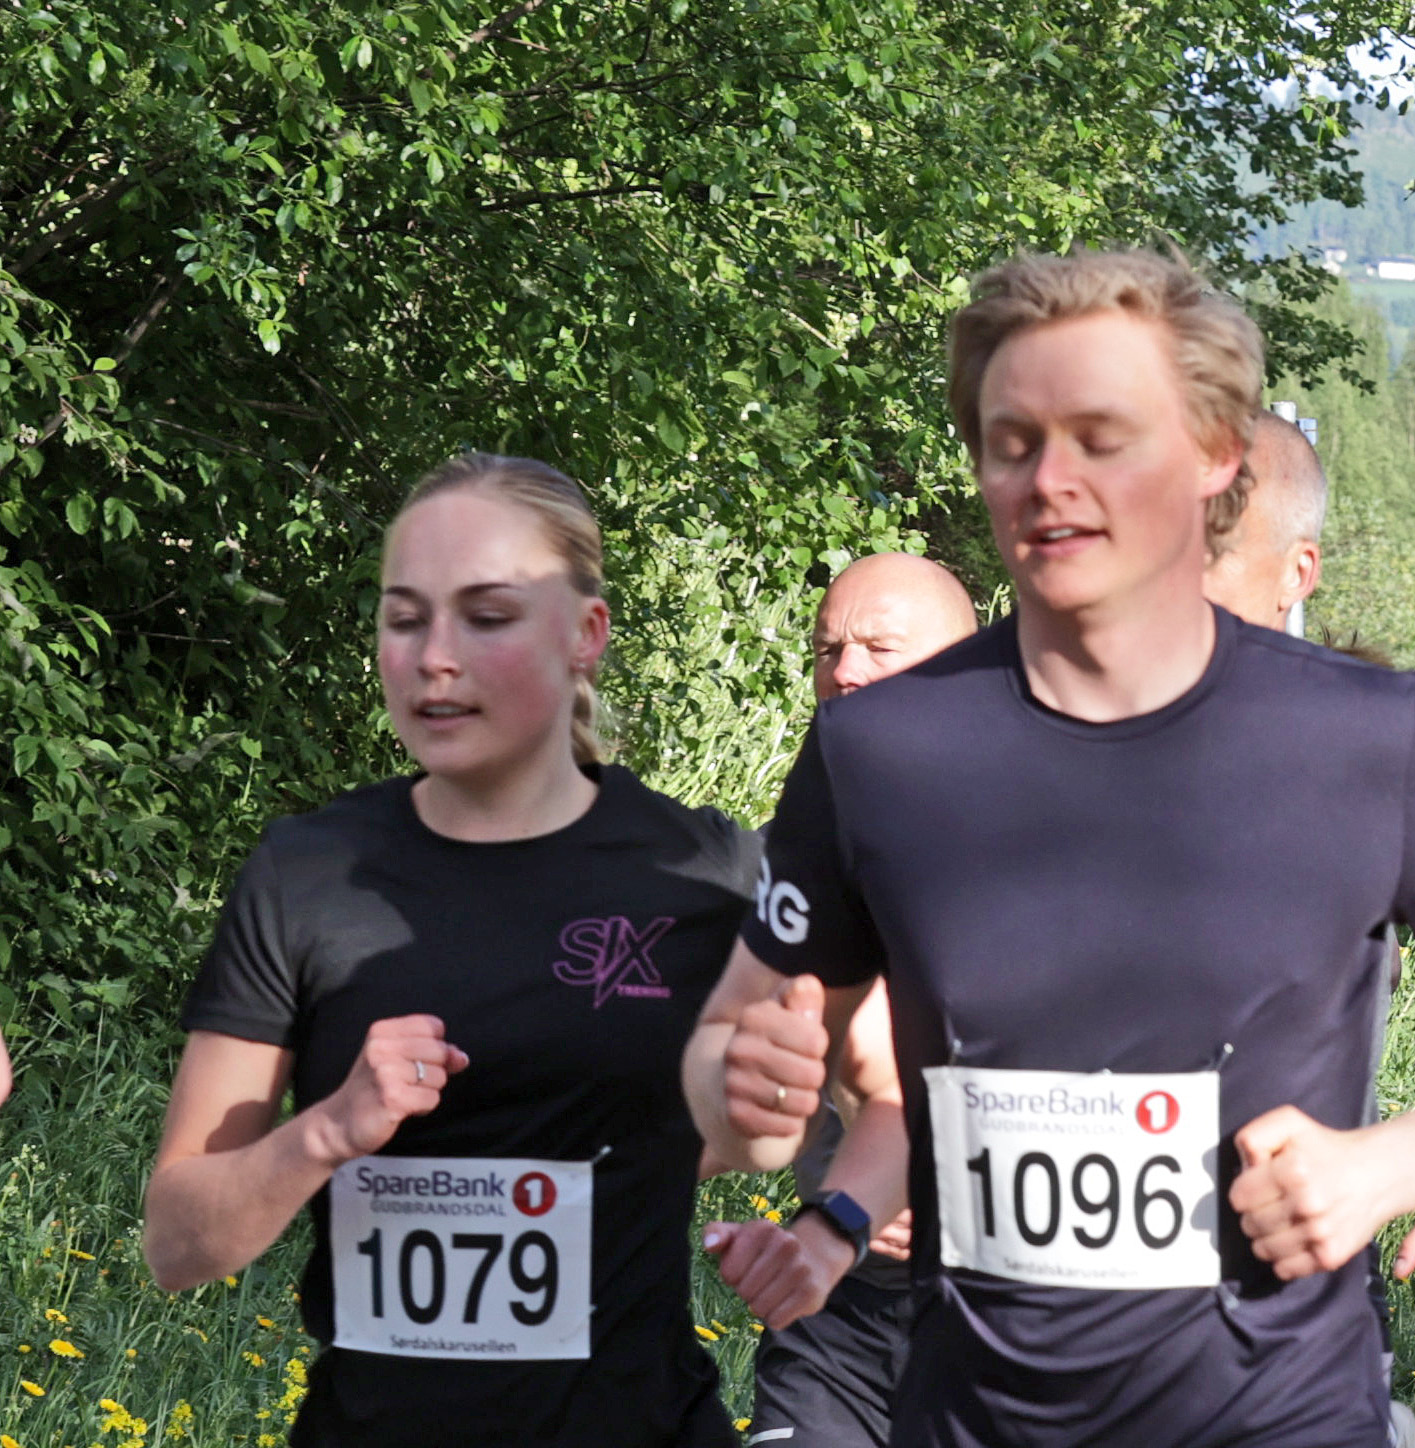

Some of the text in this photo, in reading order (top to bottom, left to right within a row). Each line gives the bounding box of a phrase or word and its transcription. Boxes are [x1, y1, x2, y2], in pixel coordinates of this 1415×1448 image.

[964, 1082, 1125, 1116] SpareBank
[357, 1167, 507, 1199] SpareBank
[967, 1147, 1184, 1250] 1096
[370, 1199, 507, 1217] GUDBRANDSDAL
[357, 1227, 559, 1327] 1079
